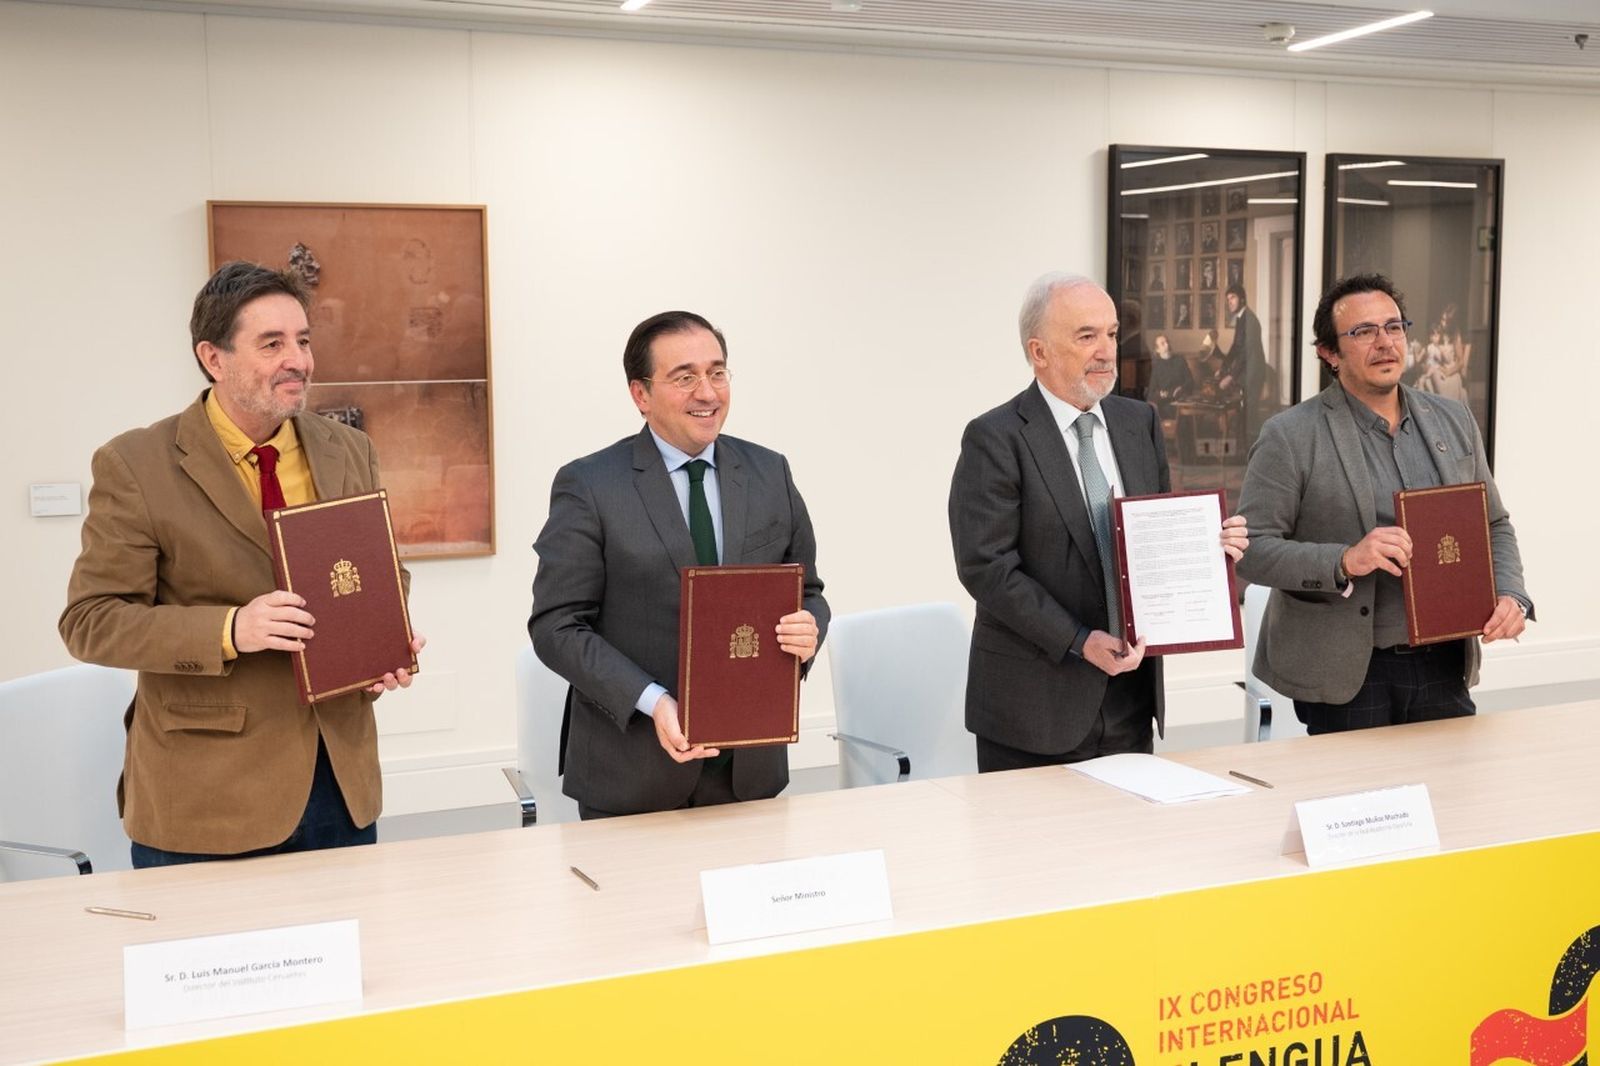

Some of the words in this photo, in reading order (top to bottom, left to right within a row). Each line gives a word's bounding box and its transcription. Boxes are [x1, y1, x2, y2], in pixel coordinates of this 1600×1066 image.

[794, 890, 826, 900] Ministro
[164, 974, 176, 983] Sr.
[179, 971, 190, 982] D.
[191, 969, 210, 980] Luis
[212, 964, 249, 977] Manuel
[283, 956, 323, 968] Montero
[1158, 995, 1182, 1021] IX
[1190, 971, 1323, 1015] CONGRESO
[1158, 998, 1360, 1053] INTERNACIONAL
